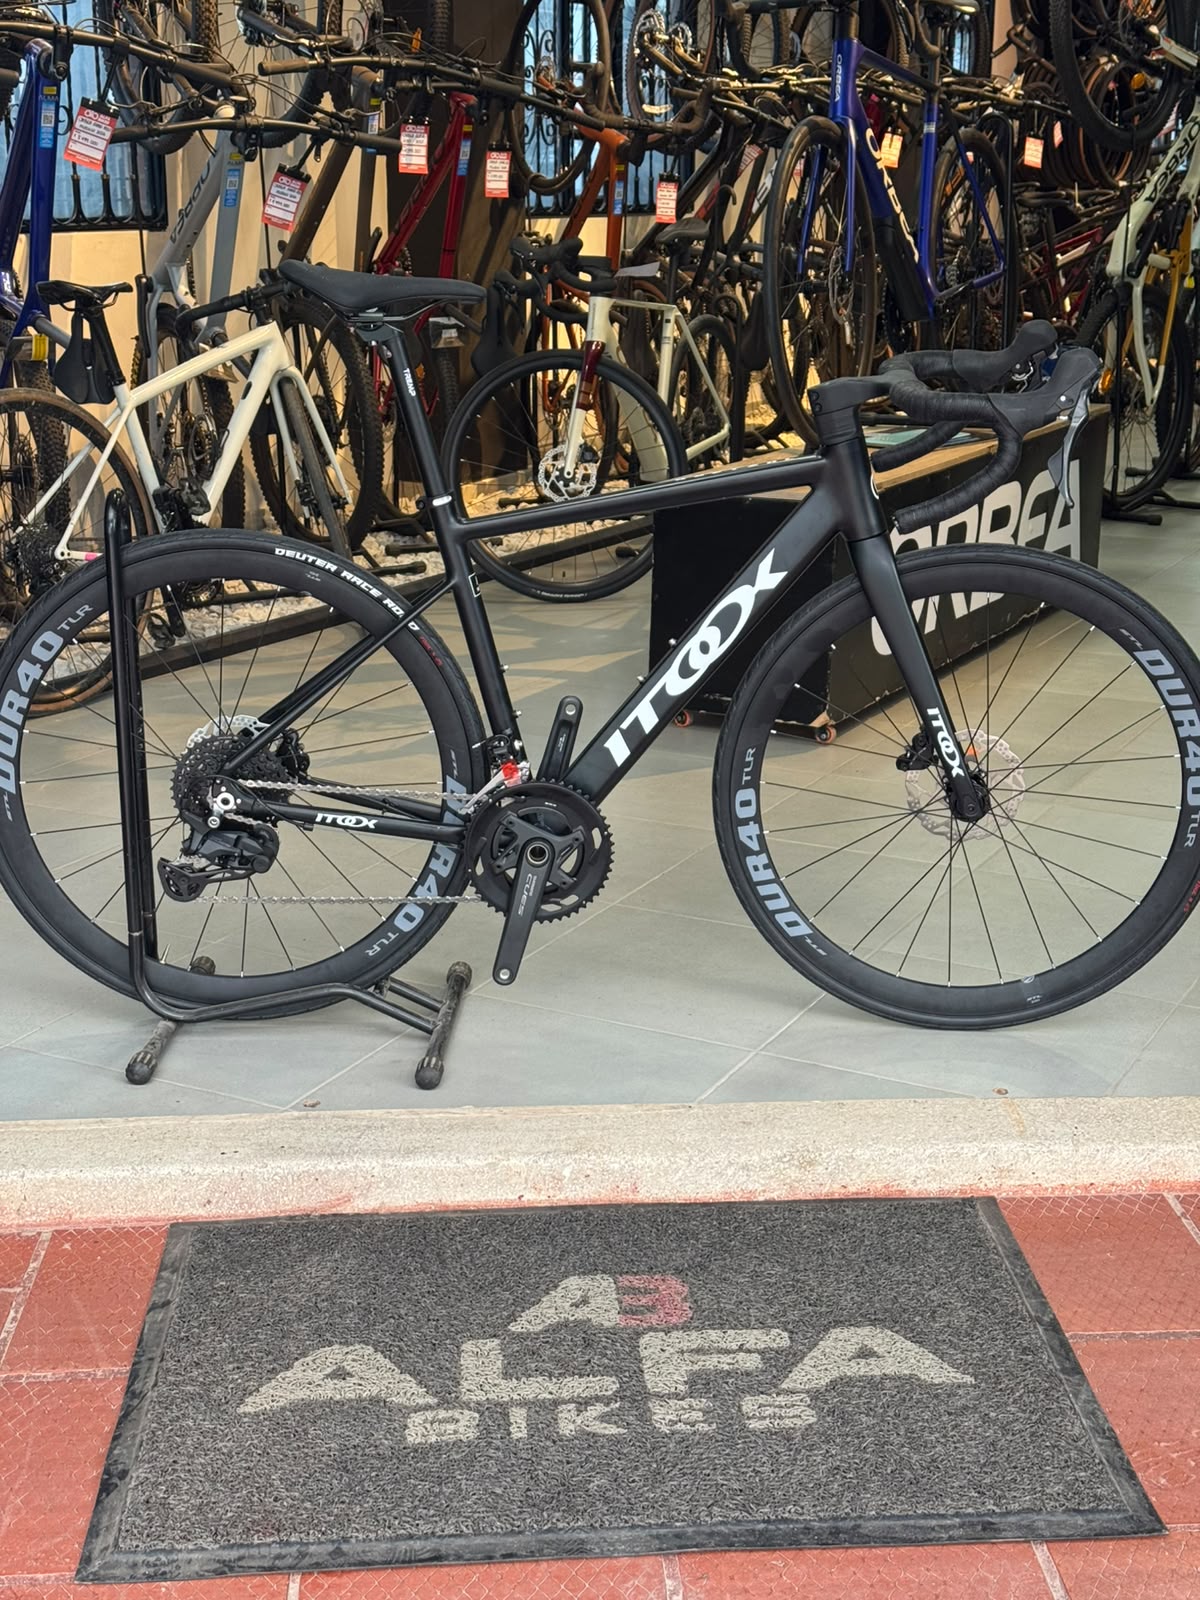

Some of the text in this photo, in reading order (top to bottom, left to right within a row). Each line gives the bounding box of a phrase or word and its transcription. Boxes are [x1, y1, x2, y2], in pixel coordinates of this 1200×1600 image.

[834, 53, 843, 103] ORBEA
[274, 547, 421, 632] DEUTER RACE ROD
[0, 630, 64, 795] DUR40
[56, 603, 94, 632] TLR
[741, 746, 757, 786] TLR
[734, 787, 814, 938] DUR40
[1183, 809, 1200, 849] TLR
[364, 931, 400, 957] TLR
[236, 1325, 976, 1415] ALFA
